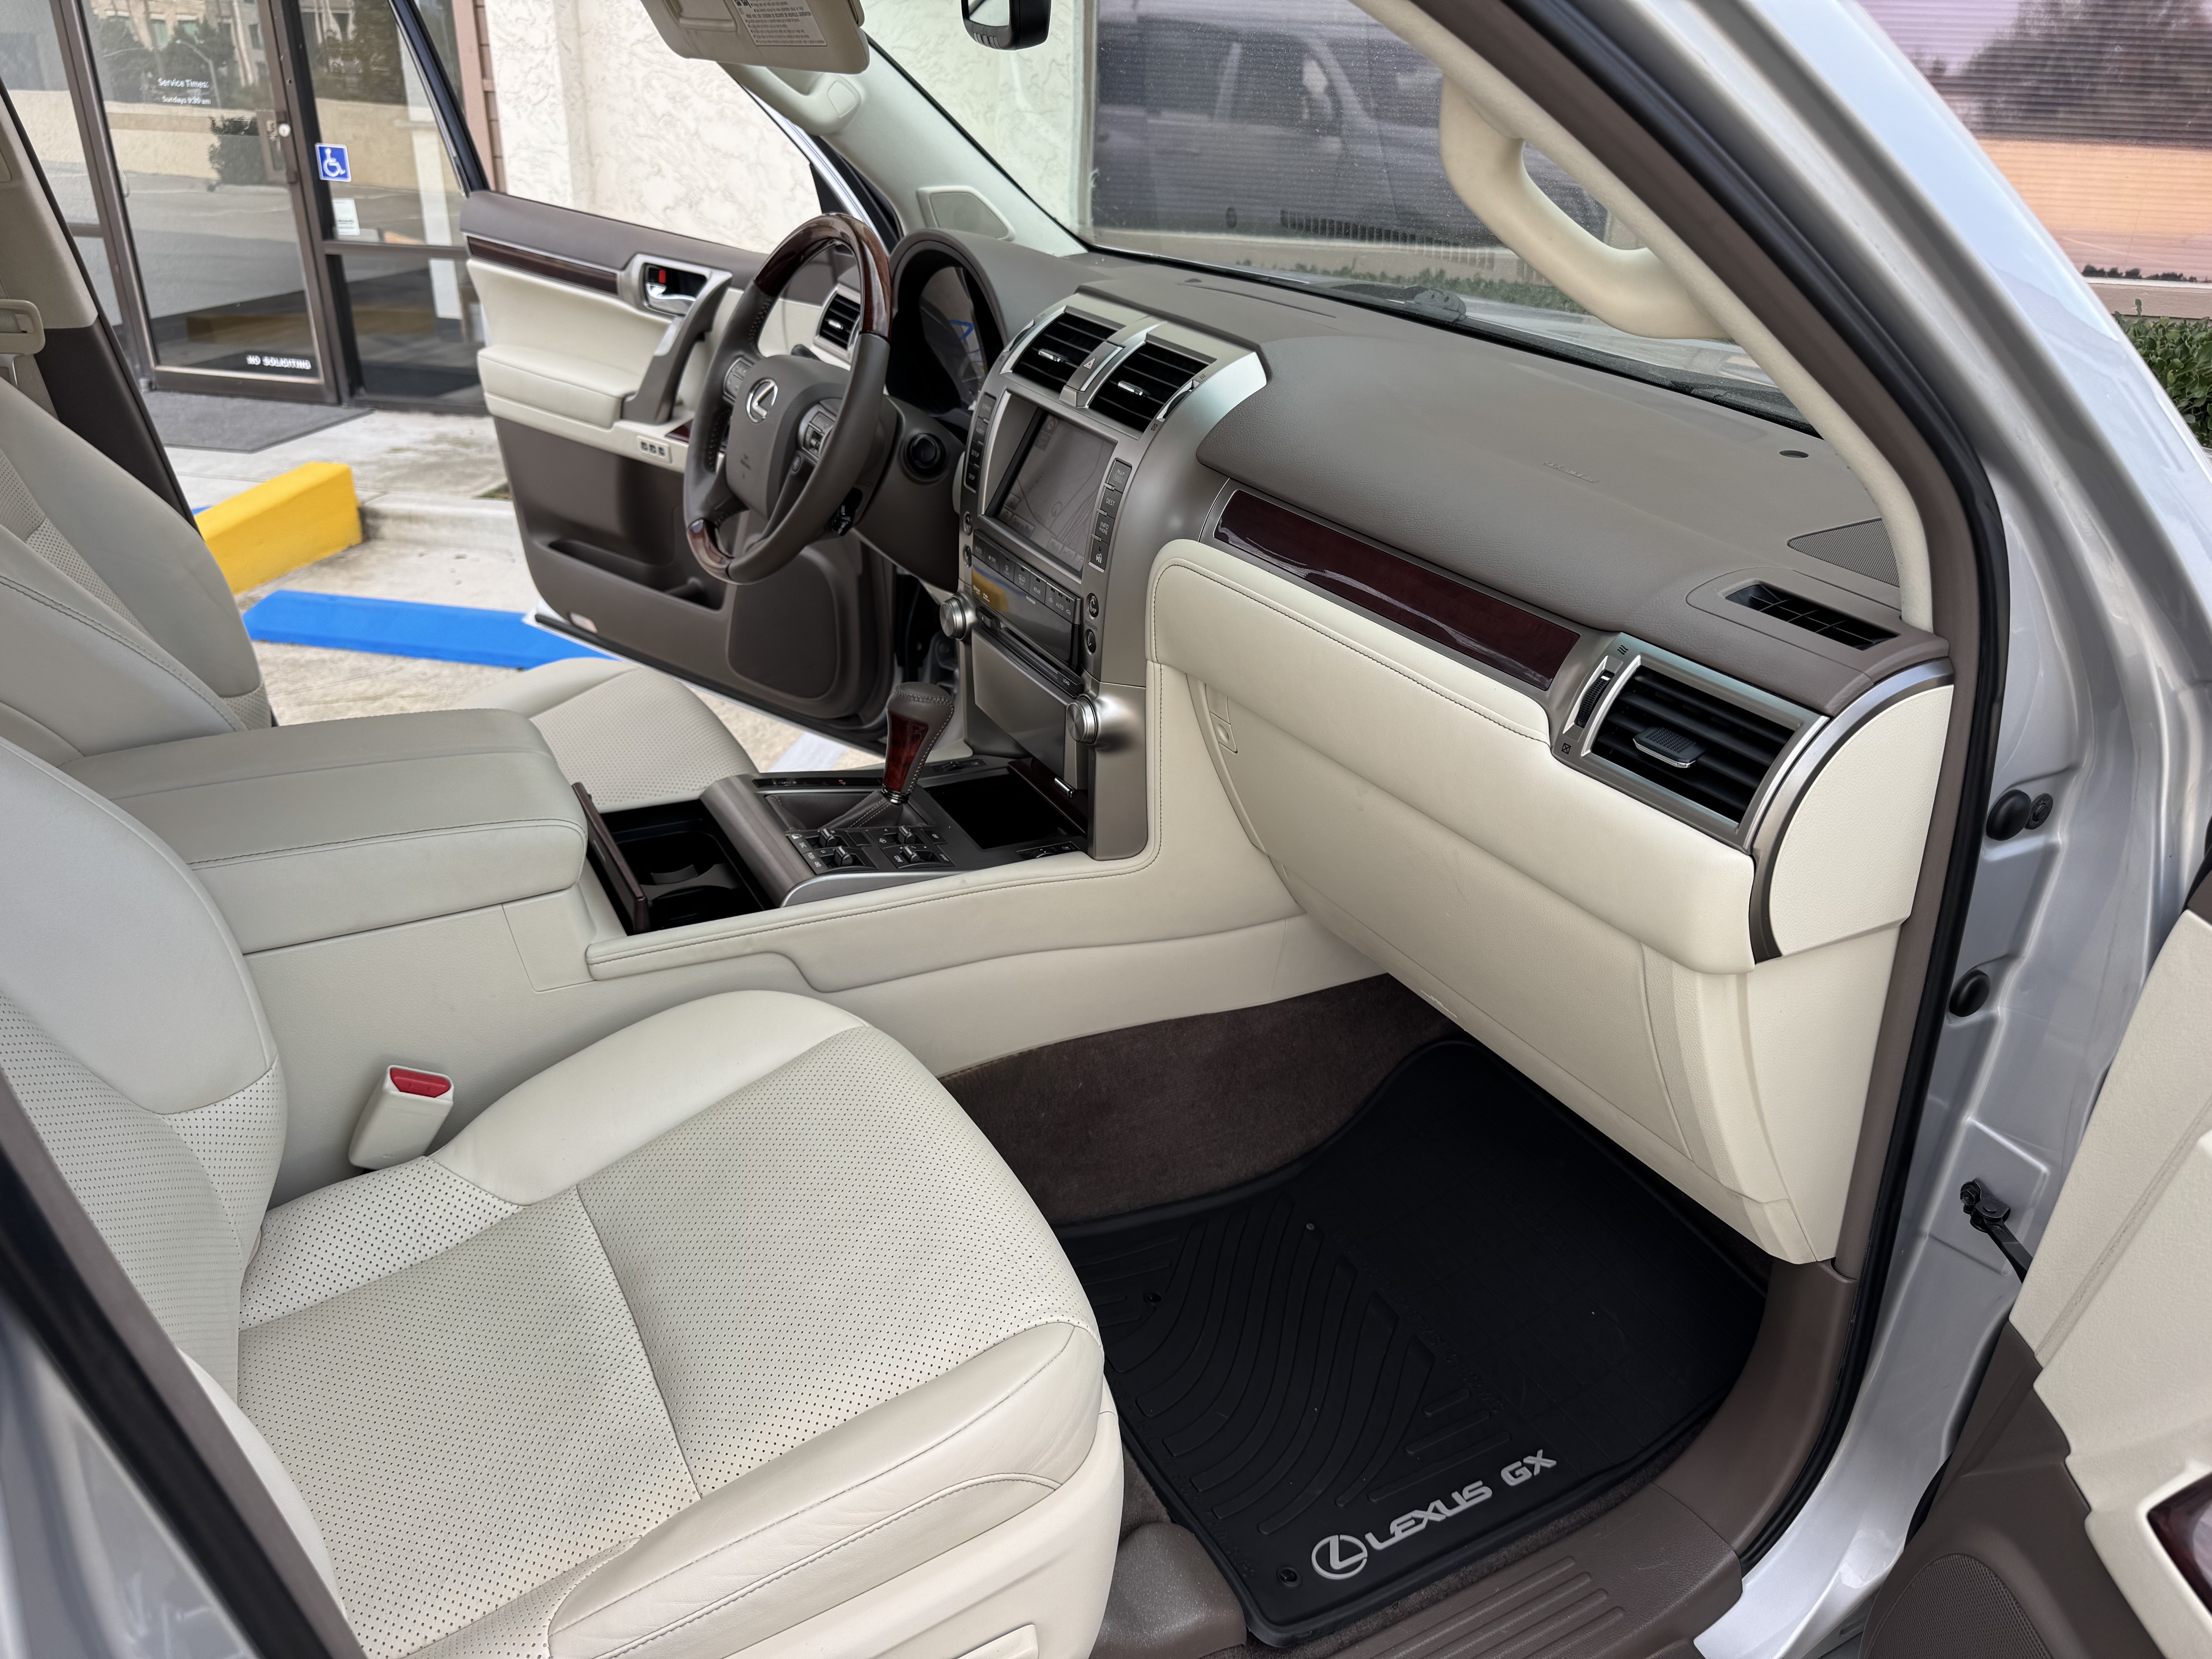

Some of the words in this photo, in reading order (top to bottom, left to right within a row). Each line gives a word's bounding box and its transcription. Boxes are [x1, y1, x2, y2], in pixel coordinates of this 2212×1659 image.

[157, 78, 185, 87] Service
[246, 354, 261, 365] NO
[262, 356, 311, 369] SOLICITING
[1106, 497, 1115, 507] DEST
[1100, 521, 1109, 530] INFO
[1099, 527, 1108, 535] PHONE
[1056, 602, 1064, 610] AUTO
[1085, 619, 1097, 631] PASSENGER
[1364, 1480, 1493, 1550] LEXUS
[1500, 1449, 1557, 1487] GX
